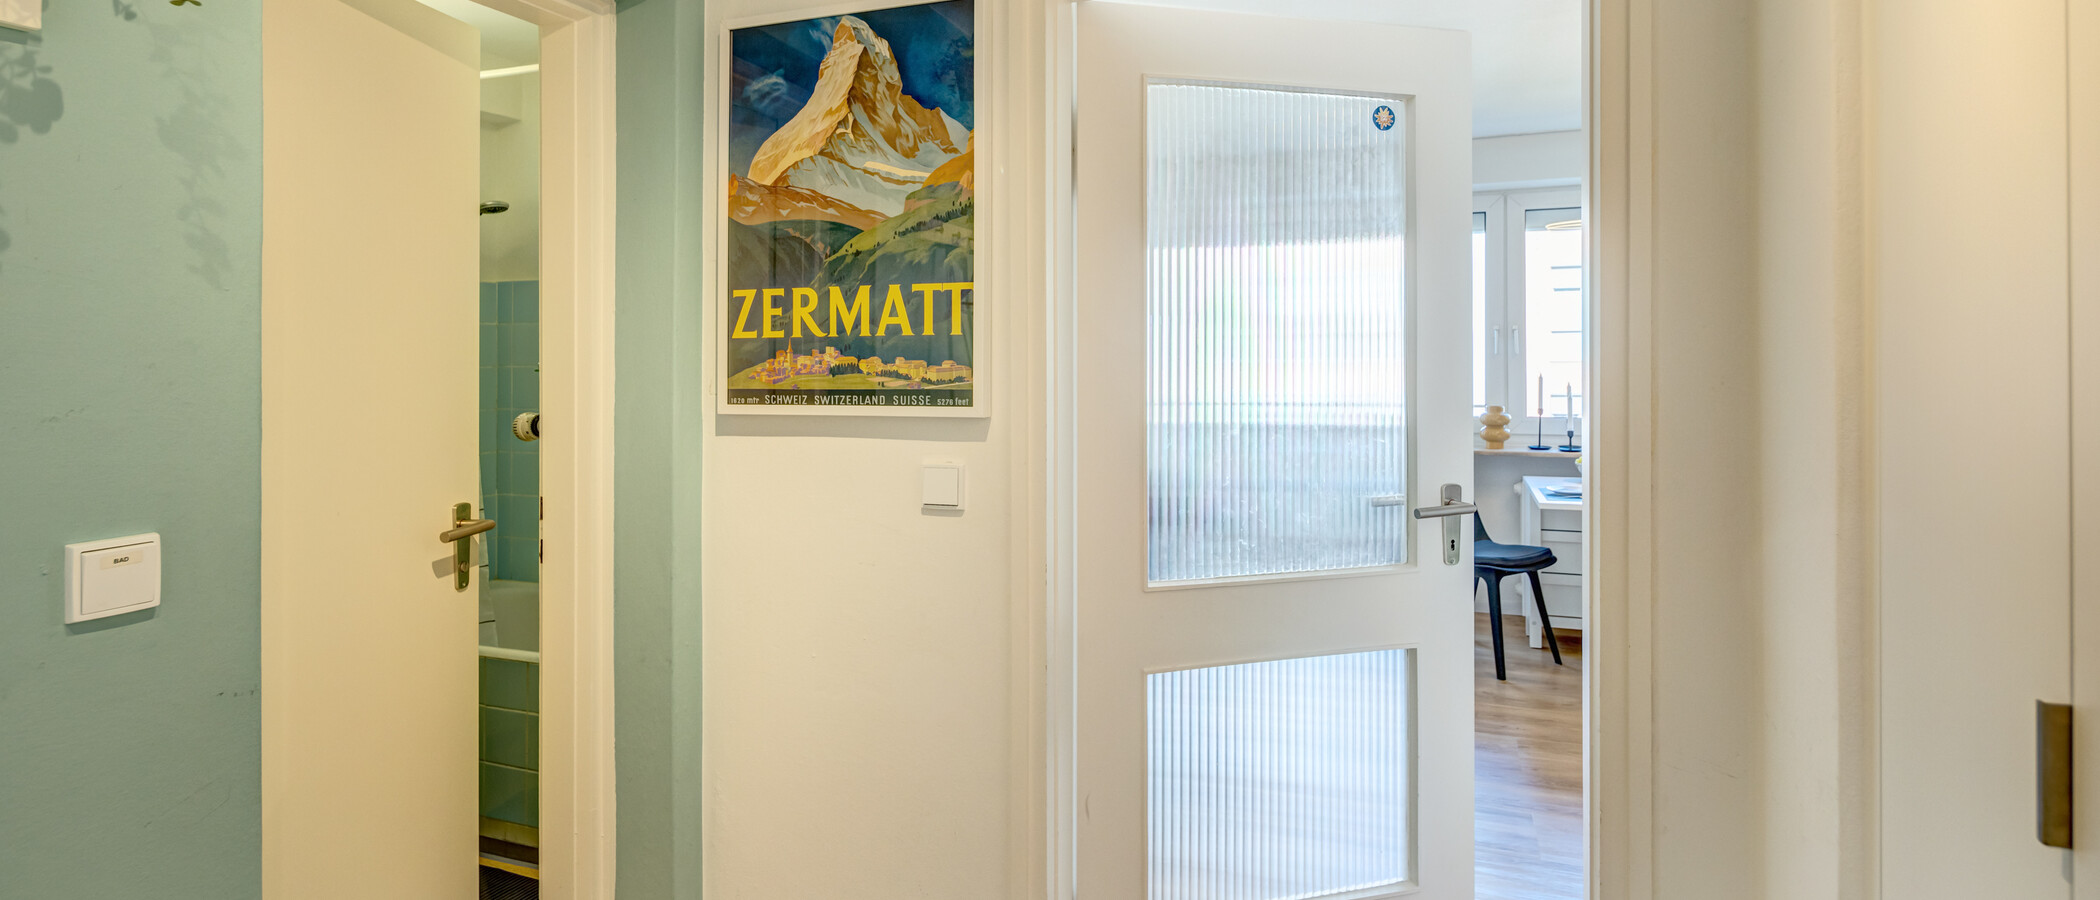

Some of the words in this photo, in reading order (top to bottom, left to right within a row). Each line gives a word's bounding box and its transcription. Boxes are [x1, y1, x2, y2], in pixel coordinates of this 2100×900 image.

[732, 282, 974, 339] ZERMATT
[746, 396, 760, 404] mtr
[764, 394, 808, 405] SCHWEIZ
[814, 394, 886, 406] SWITZERLAND
[892, 395, 932, 406] SUISSE
[954, 397, 970, 406] feet
[113, 556, 130, 564] BAD
